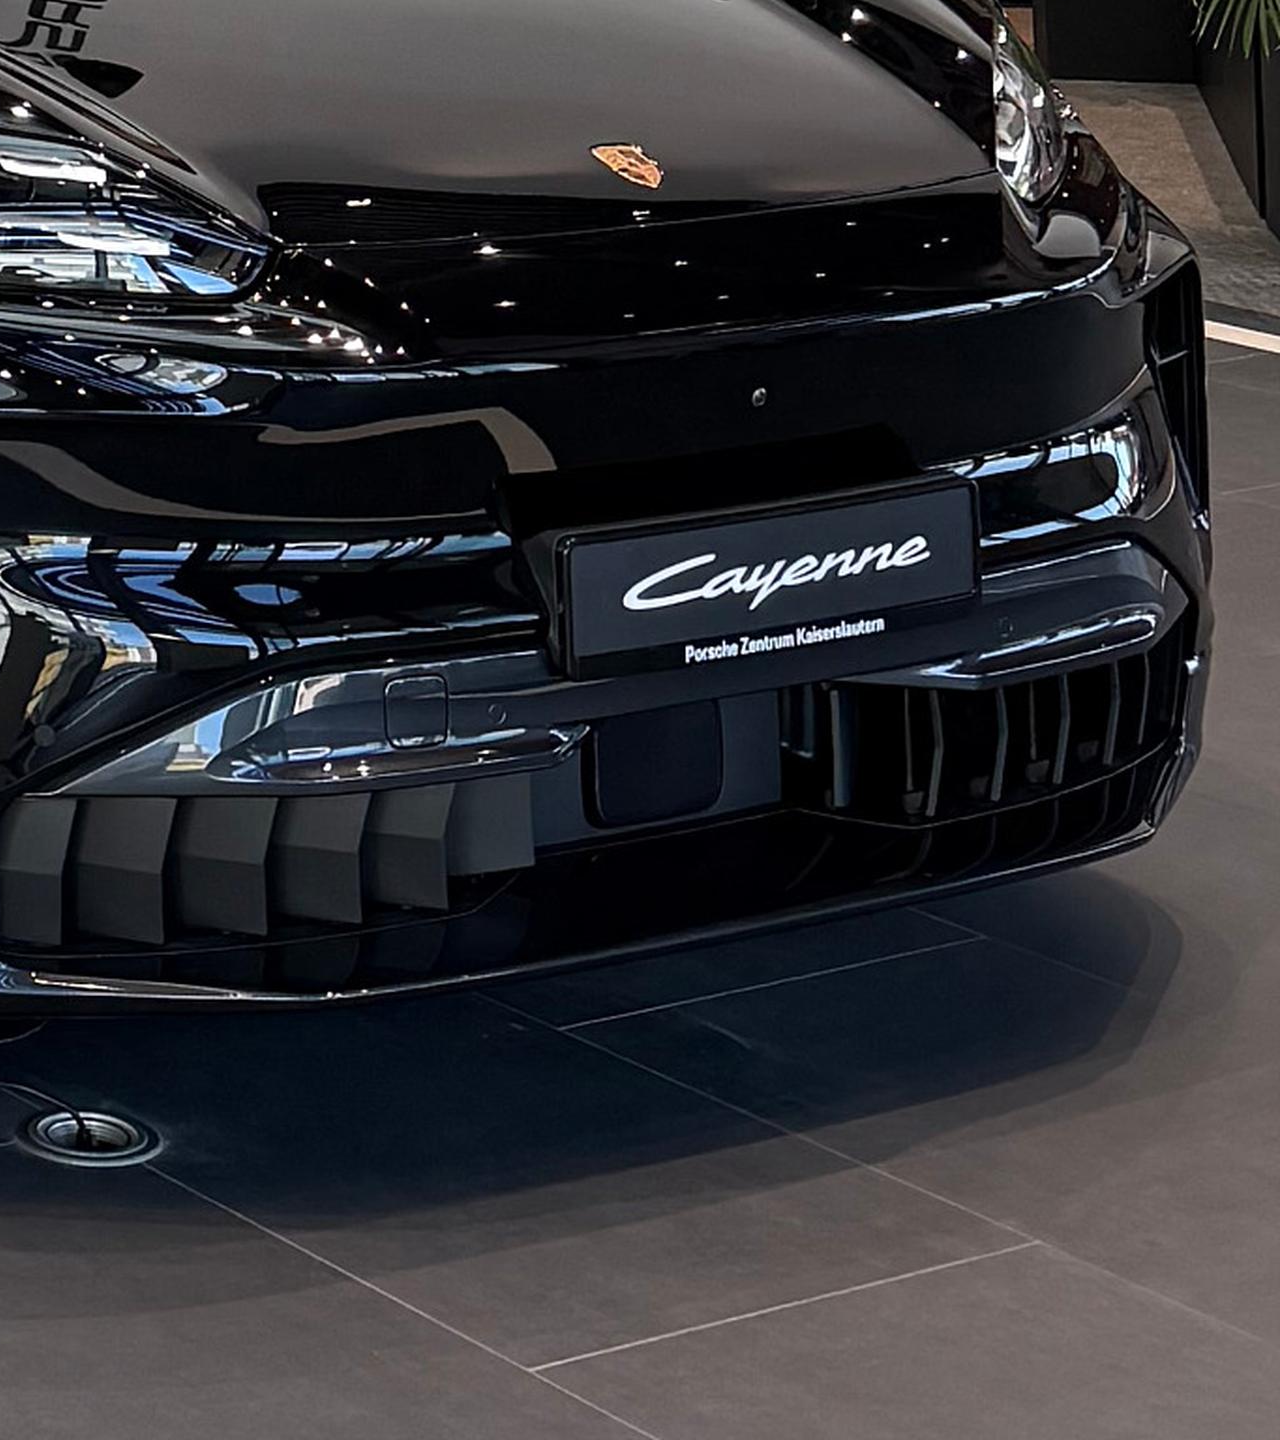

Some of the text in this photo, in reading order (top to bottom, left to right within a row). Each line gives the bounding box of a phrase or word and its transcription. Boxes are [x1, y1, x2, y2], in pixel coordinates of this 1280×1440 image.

[621, 533, 932, 612] Cayenne
[684, 616, 886, 665] Porsche Zentrum Kaiserslautern
